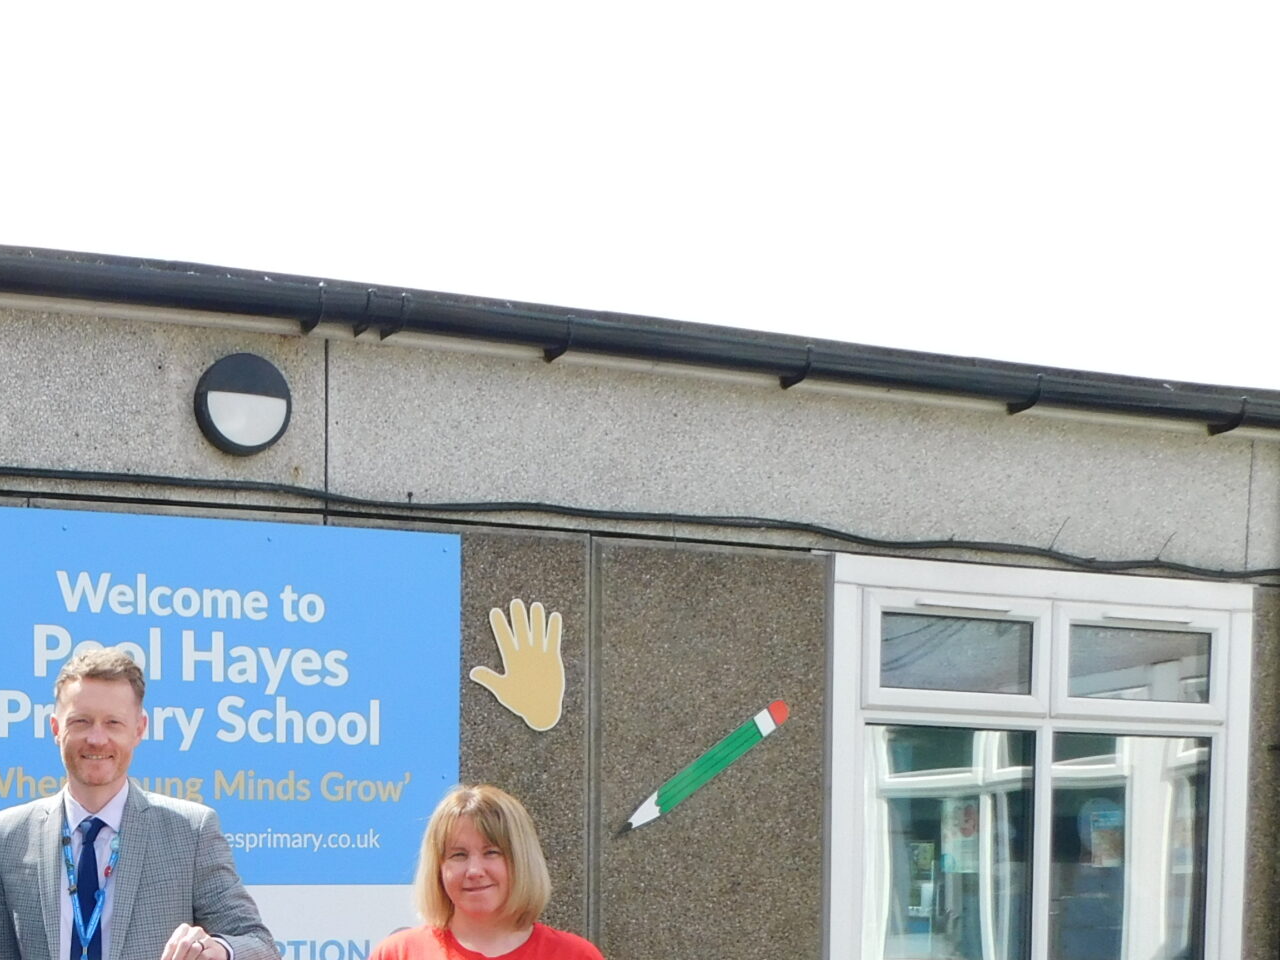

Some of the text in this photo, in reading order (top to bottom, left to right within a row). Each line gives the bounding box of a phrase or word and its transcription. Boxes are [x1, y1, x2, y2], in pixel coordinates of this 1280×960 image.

[56, 570, 325, 623] Welcome to
[182, 629, 349, 695] Hayes
[216, 695, 380, 746] School
[214, 769, 312, 801] Minds
[224, 828, 381, 853] esprimary.co.uk
